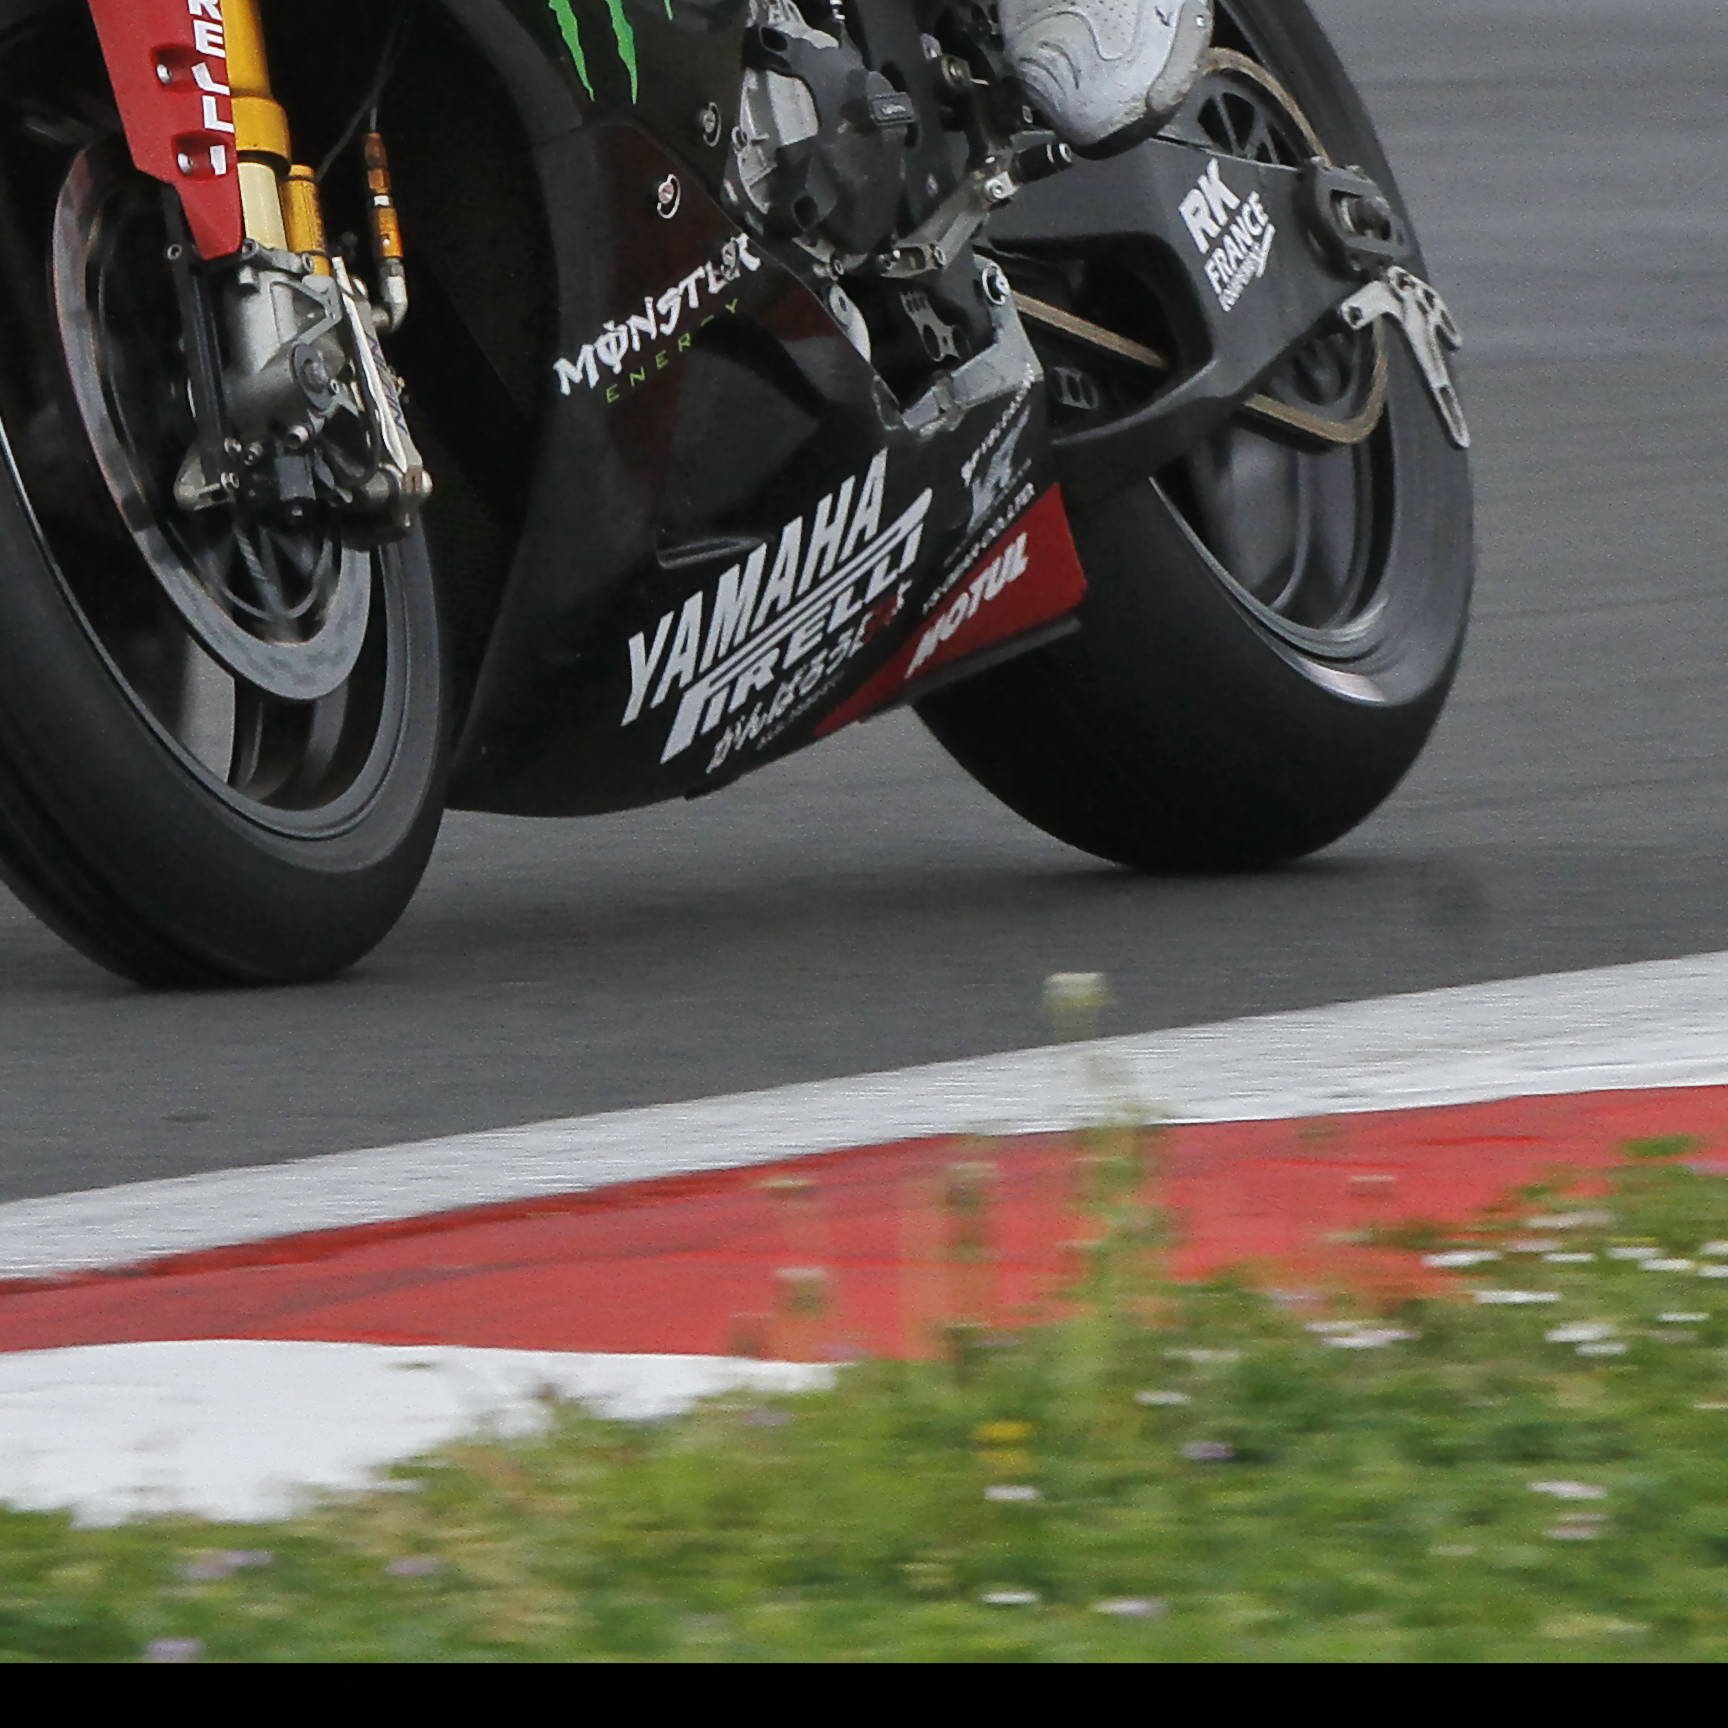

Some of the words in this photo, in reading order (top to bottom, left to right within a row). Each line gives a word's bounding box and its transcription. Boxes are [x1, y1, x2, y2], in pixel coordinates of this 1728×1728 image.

[1178, 157, 1241, 254] RK
[1204, 190, 1270, 294] FRANCE
[620, 447, 889, 727] YAMAHA
[660, 486, 933, 764] PIRELLI
[904, 531, 1030, 680] MOTUL
